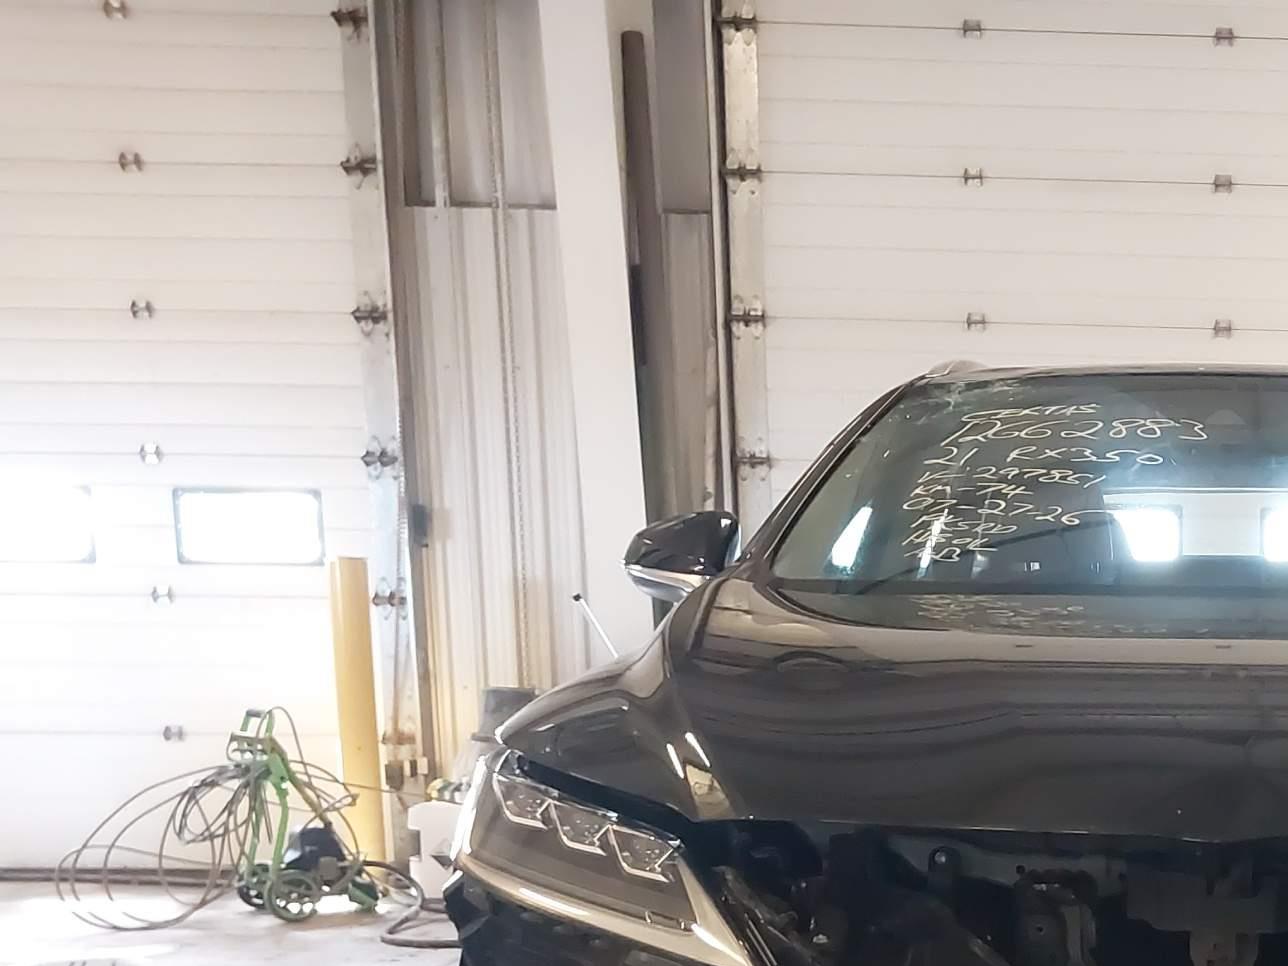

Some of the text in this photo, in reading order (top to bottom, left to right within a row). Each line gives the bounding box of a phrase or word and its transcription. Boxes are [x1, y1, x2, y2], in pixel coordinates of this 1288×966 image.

[940, 418, 1208, 446] 12662883
[923, 446, 1165, 466] 21 RX350
